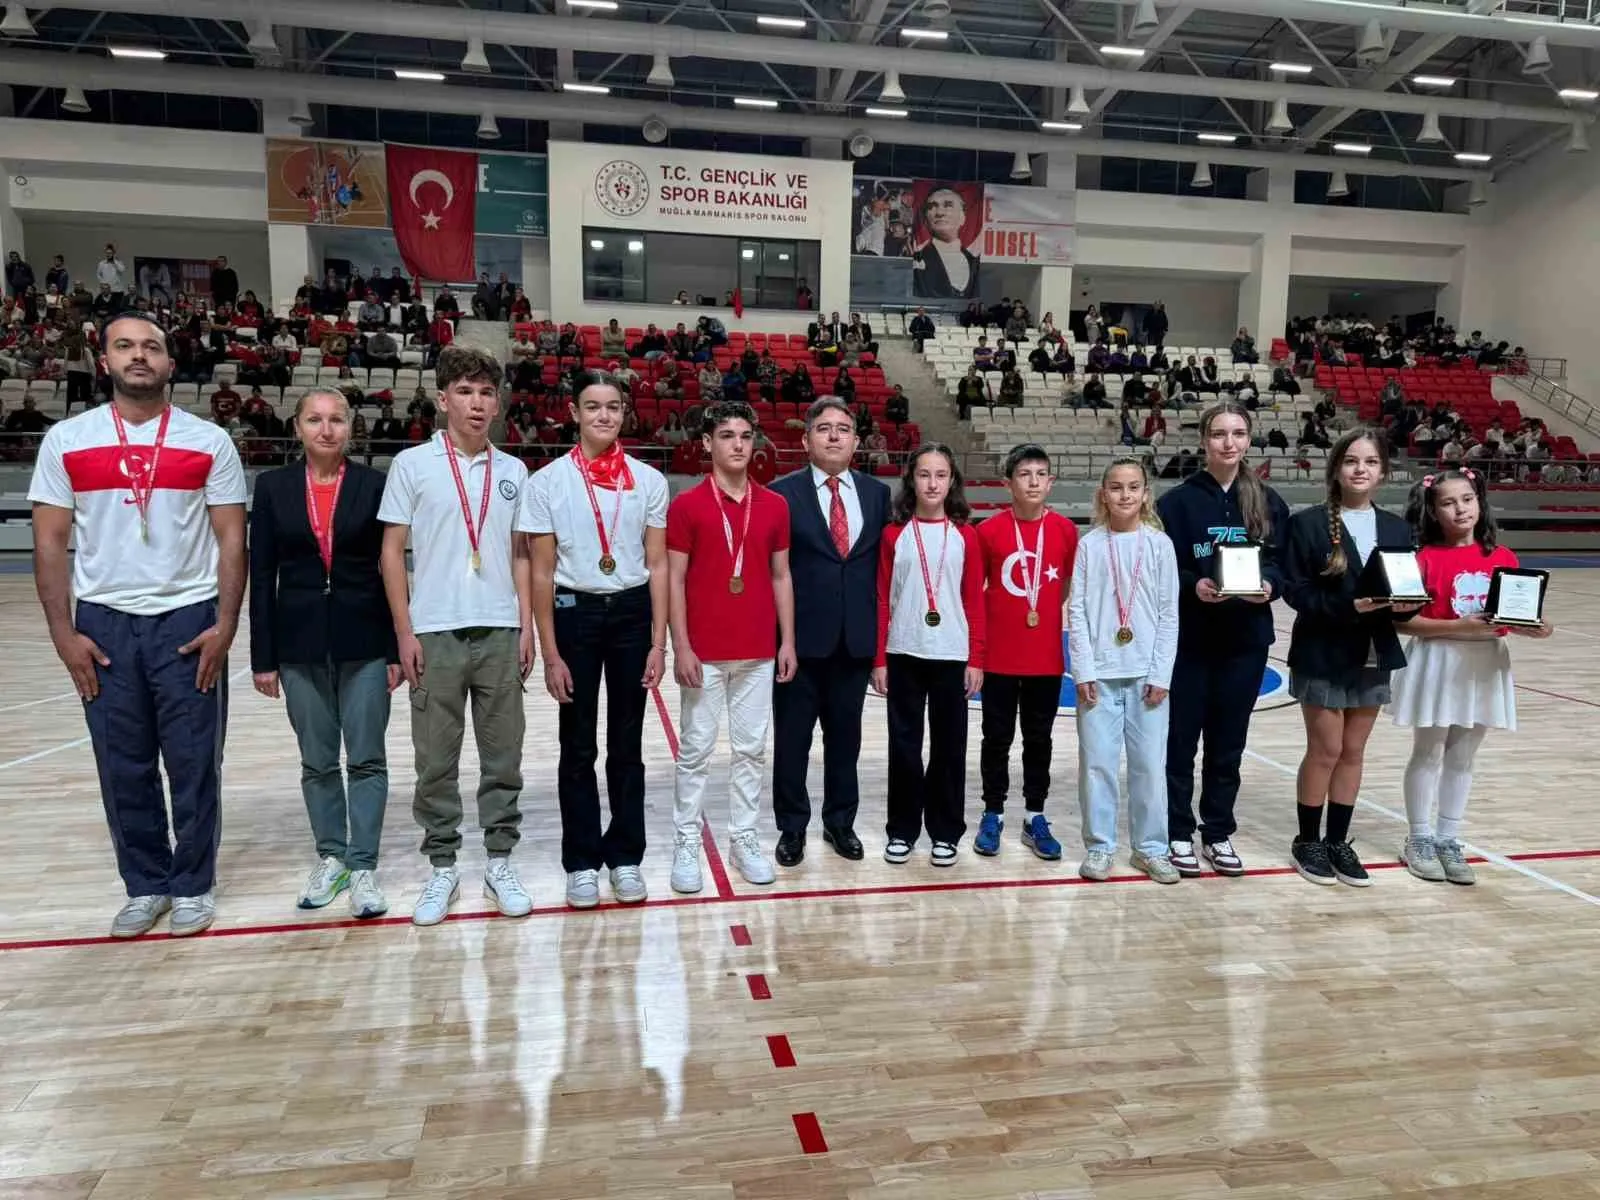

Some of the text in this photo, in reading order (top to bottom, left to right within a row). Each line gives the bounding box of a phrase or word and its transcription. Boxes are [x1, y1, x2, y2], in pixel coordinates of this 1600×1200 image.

[475, 164, 490, 193] E
[660, 165, 808, 189] T.C. GENÇLİK VE
[660, 185, 709, 203] SPOR
[714, 189, 808, 211] BAKANLIĞI
[744, 212, 769, 220] SPOR
[771, 214, 807, 223] SALONU
